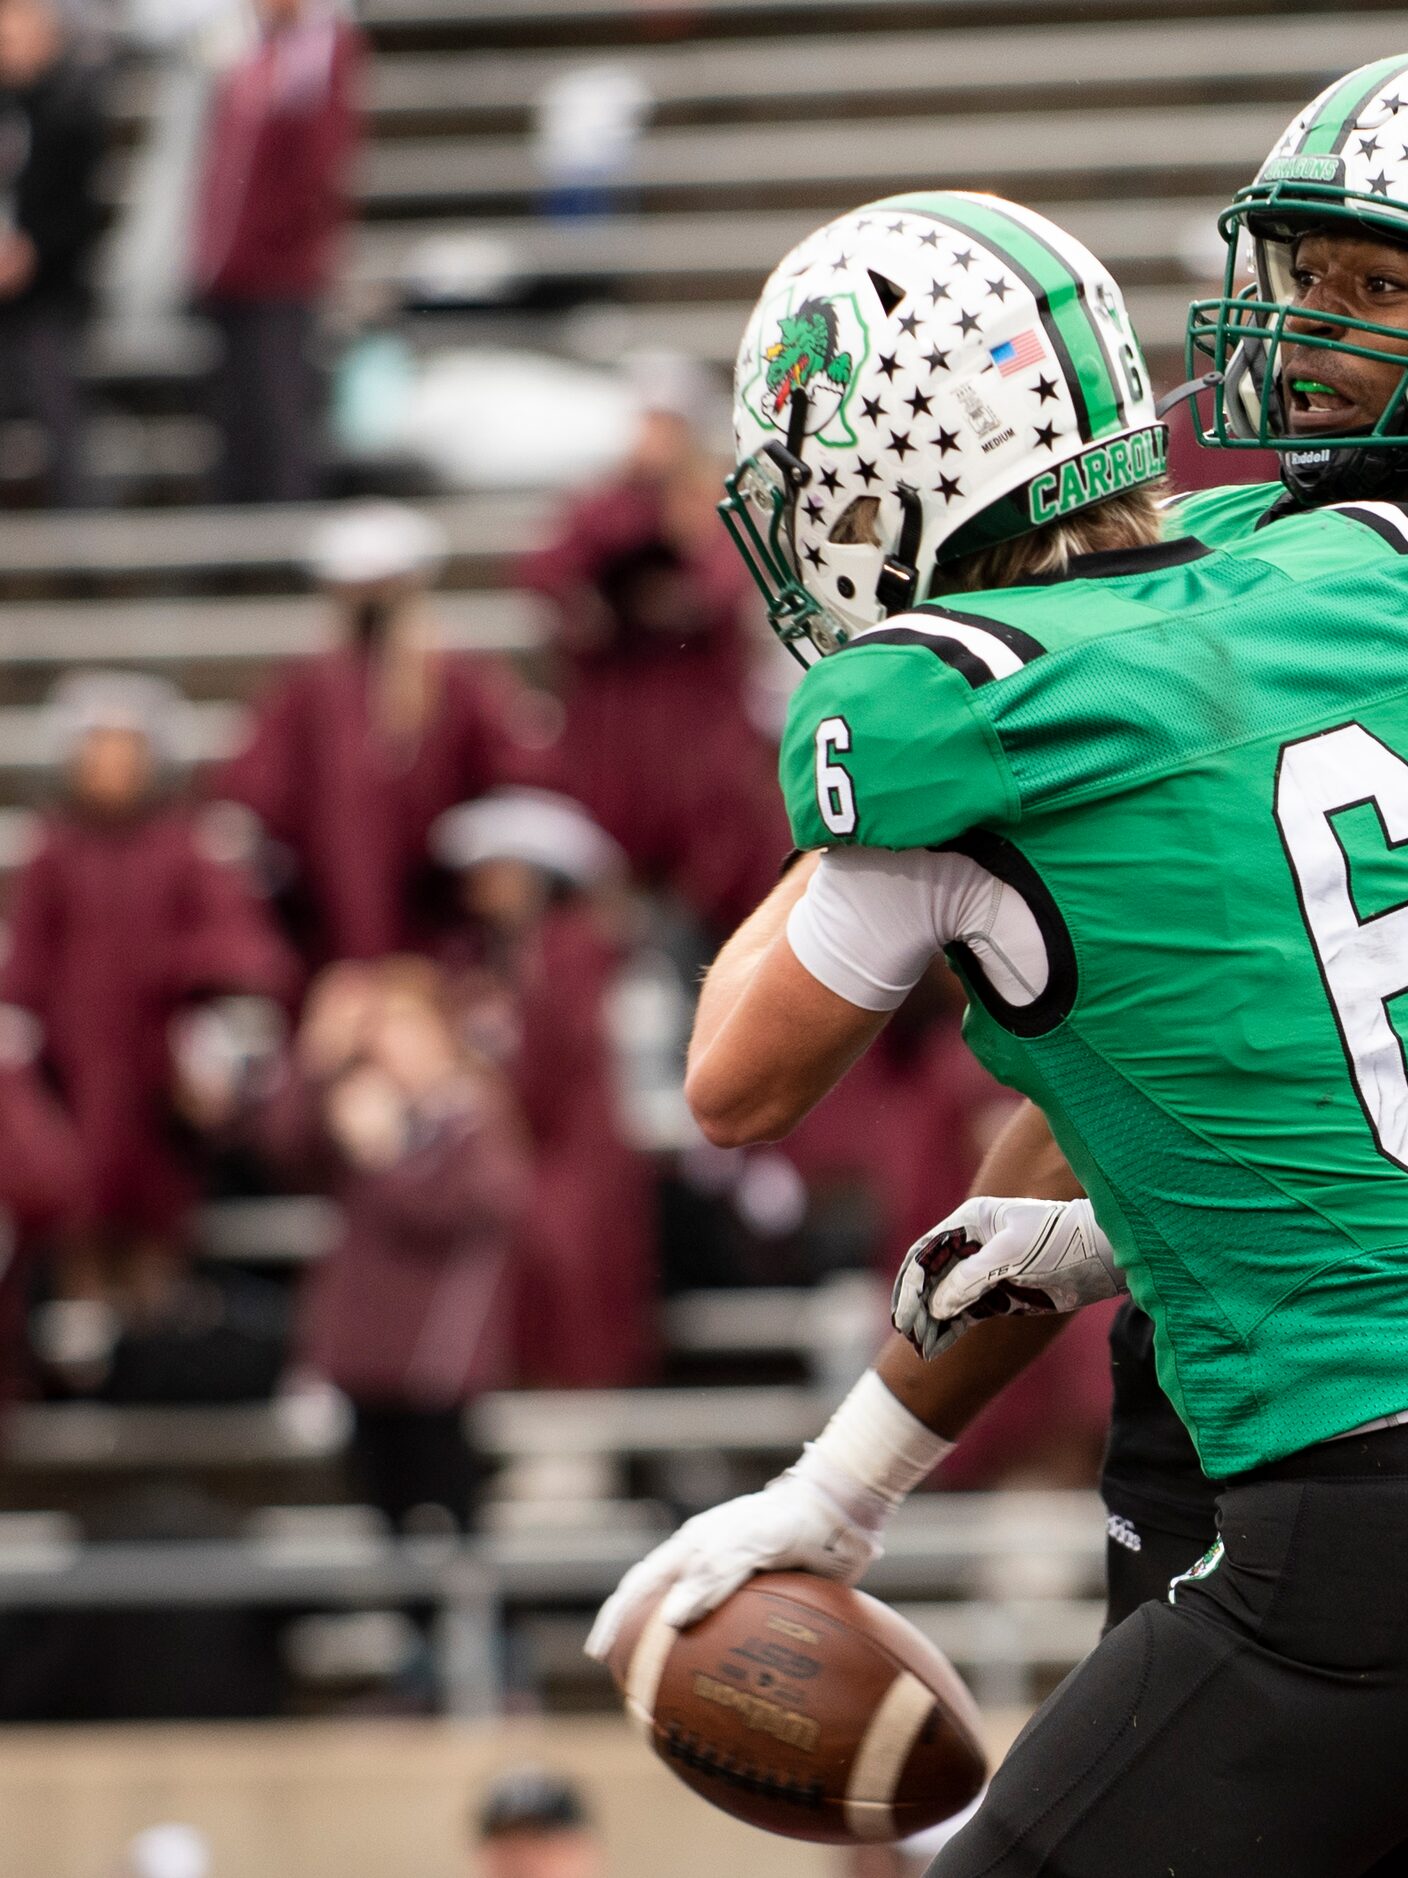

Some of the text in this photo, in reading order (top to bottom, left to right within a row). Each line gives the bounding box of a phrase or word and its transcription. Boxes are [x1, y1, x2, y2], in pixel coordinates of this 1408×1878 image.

[1264, 157, 1339, 181] DRAGONS
[1118, 343, 1144, 404] 6
[981, 427, 1016, 454] MEDIUM
[1028, 425, 1167, 526] CARROLL
[814, 715, 860, 837] 6
